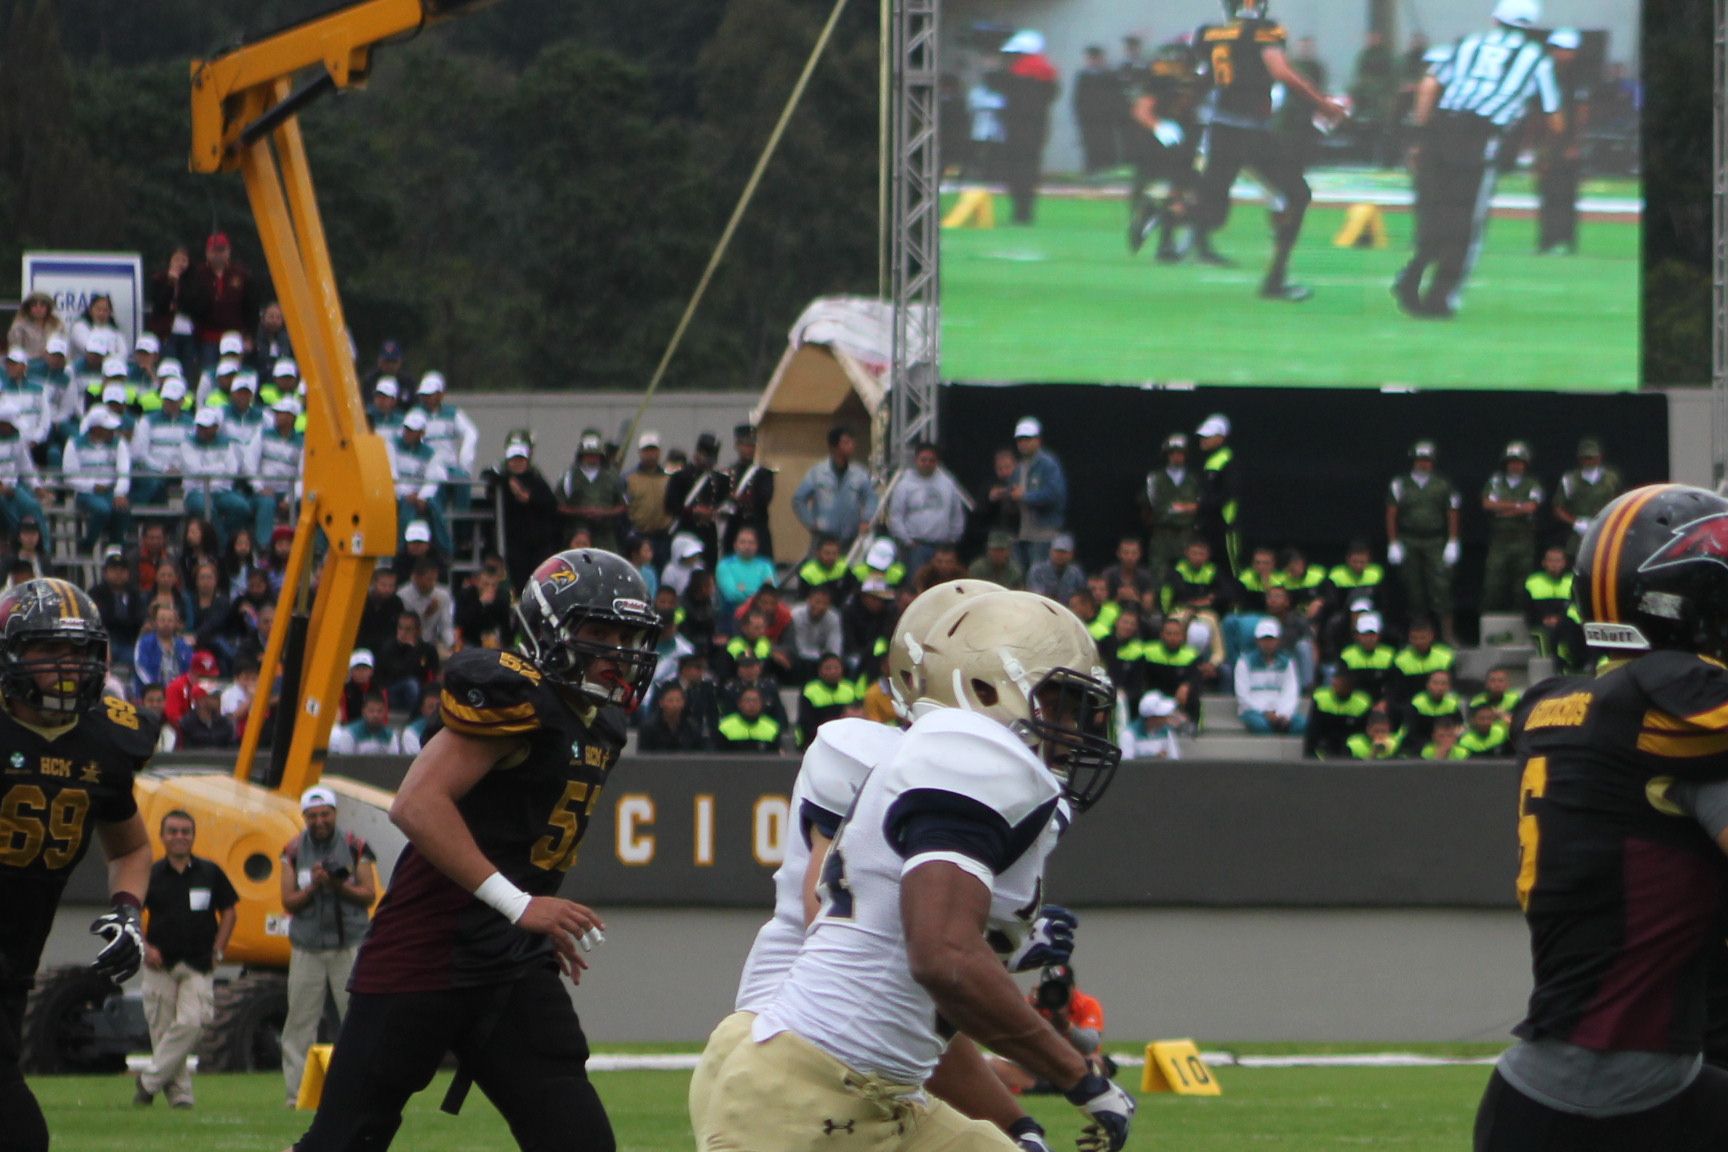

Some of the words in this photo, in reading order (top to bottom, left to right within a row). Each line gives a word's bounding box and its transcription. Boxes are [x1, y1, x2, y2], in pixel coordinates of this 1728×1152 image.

[40, 757, 72, 777] HCM
[0, 784, 90, 871] 69
[1171, 1056, 1209, 1087] 10
